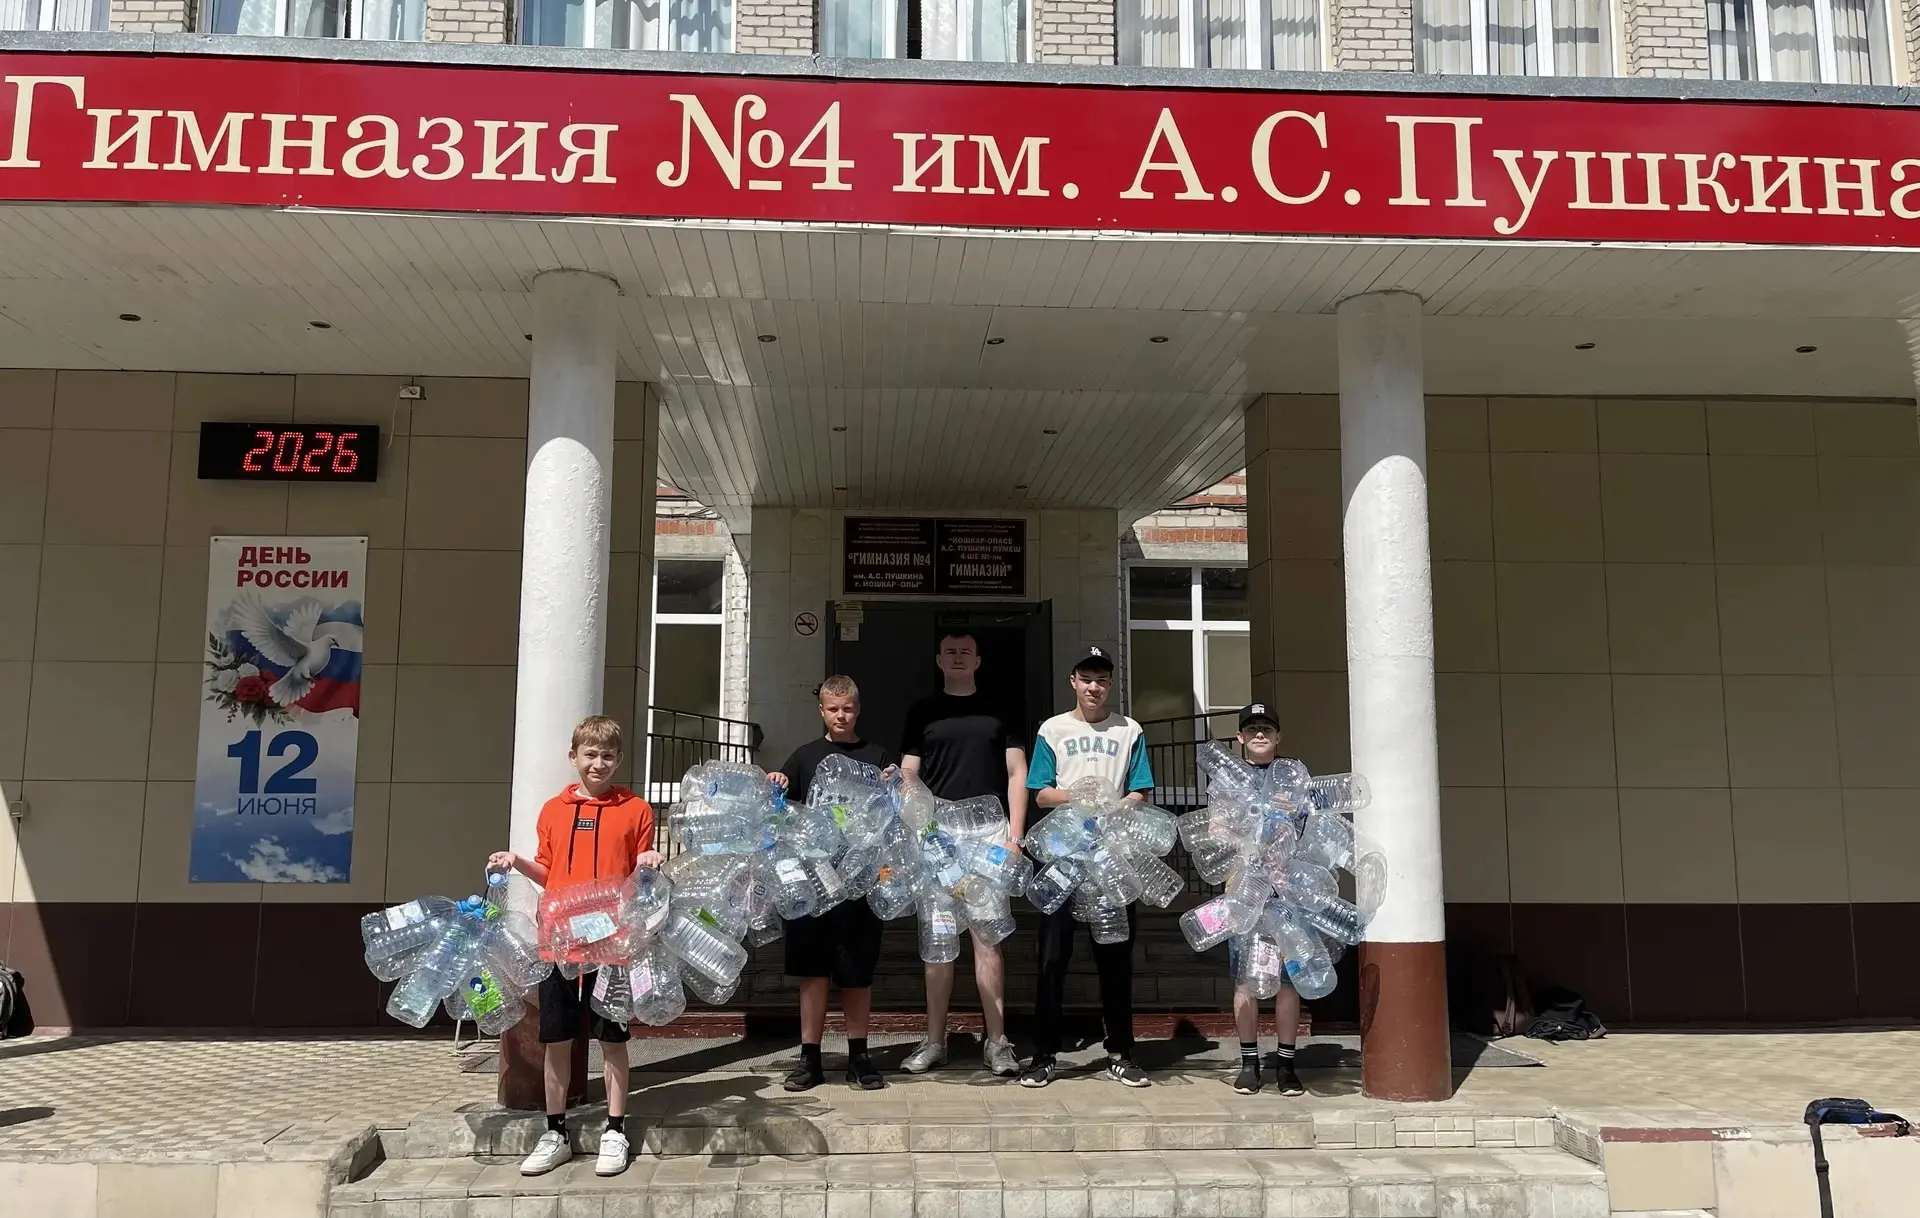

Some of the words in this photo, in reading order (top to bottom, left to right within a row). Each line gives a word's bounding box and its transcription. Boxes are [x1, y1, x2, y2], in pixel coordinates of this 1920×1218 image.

[0, 76, 618, 183] Гимназия
[657, 94, 854, 190] №4
[893, 133, 1079, 199] им.
[242, 431, 359, 473] 2026
[238, 546, 311, 567] ДЕНЬ
[913, 553, 931, 566] №4
[237, 570, 349, 588] РОССИИ
[1064, 736, 1120, 757] ROAD
[227, 730, 320, 794] 12
[237, 797, 317, 816] ИЮНЯ
